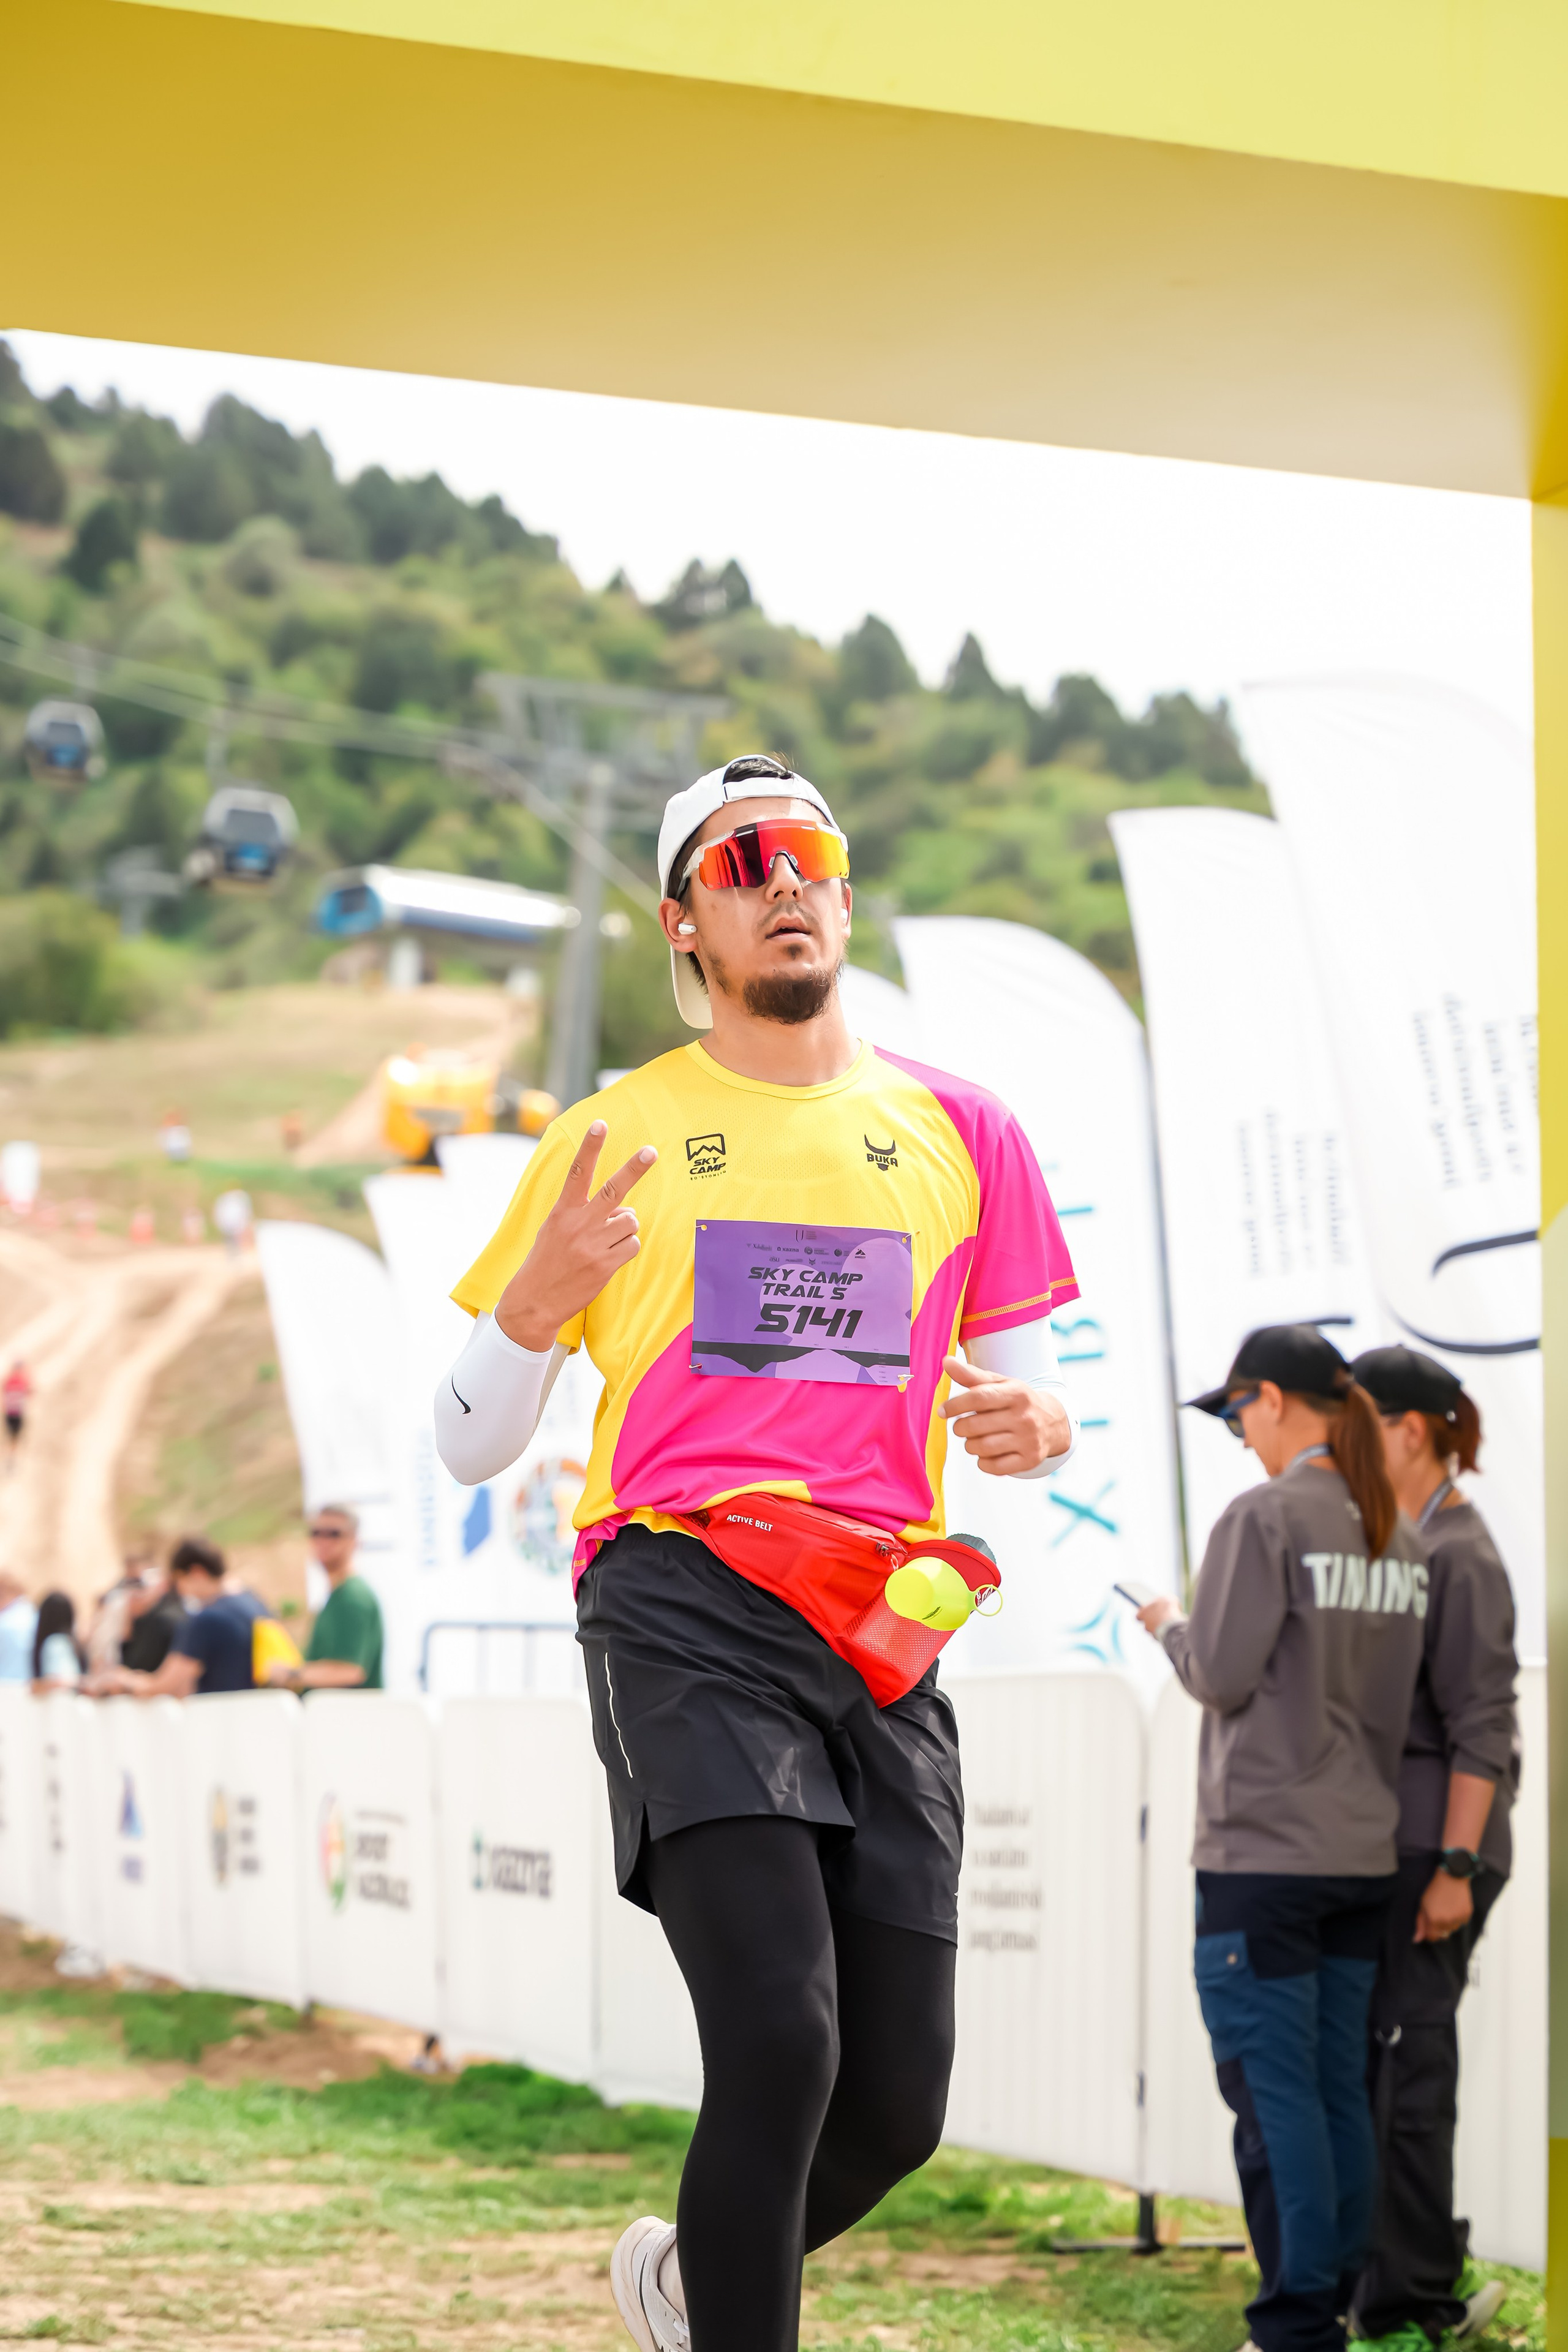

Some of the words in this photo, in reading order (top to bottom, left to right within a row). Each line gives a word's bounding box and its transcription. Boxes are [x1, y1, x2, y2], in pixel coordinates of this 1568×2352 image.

[693, 1156, 720, 1167] SKY
[867, 1153, 899, 1167] BUKA
[690, 1163, 726, 1175] CAMP
[748, 1267, 795, 1281] SKY
[799, 1270, 863, 1286] CAMP
[762, 1283, 824, 1299] TRAIL
[753, 1303, 864, 1339] 5141
[726, 1514, 753, 1526] ACTIVE
[755, 1520, 774, 1532] BELT
[1301, 1551, 1430, 1621] TIMING
